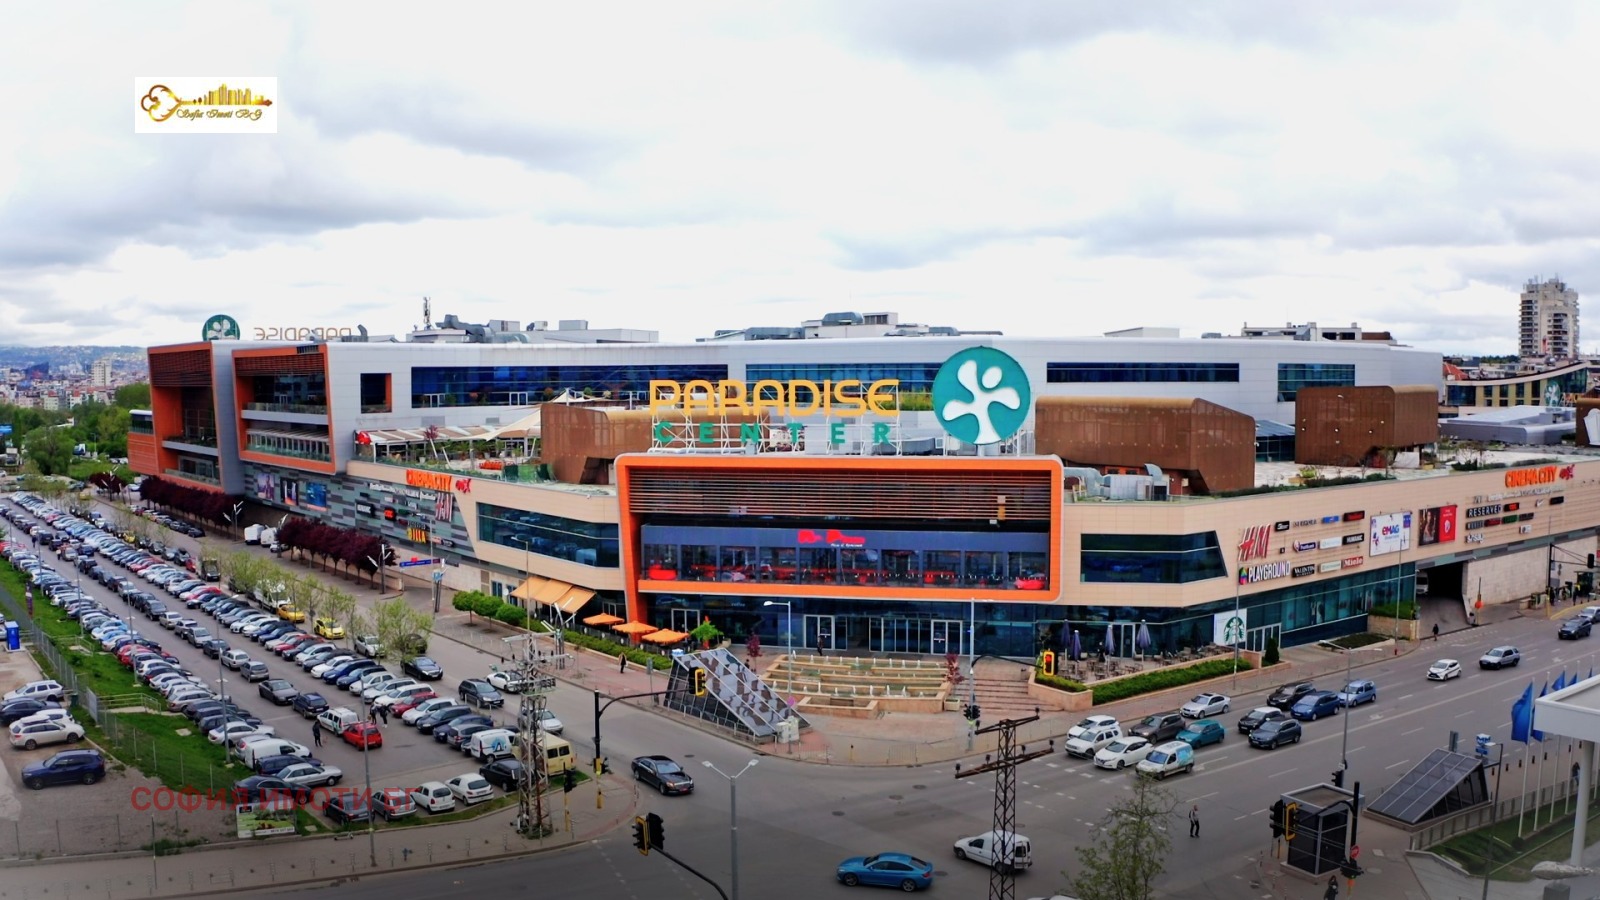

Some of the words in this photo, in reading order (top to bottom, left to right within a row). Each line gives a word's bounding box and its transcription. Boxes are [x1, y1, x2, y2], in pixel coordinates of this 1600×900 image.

[650, 379, 899, 417] PARADISE
[654, 420, 891, 444] CENTER
[1505, 467, 1538, 488] CINEMA
[1539, 465, 1557, 484] CITY
[1468, 504, 1502, 517] RESERVED
[1249, 560, 1291, 582] PLAYGROUND
